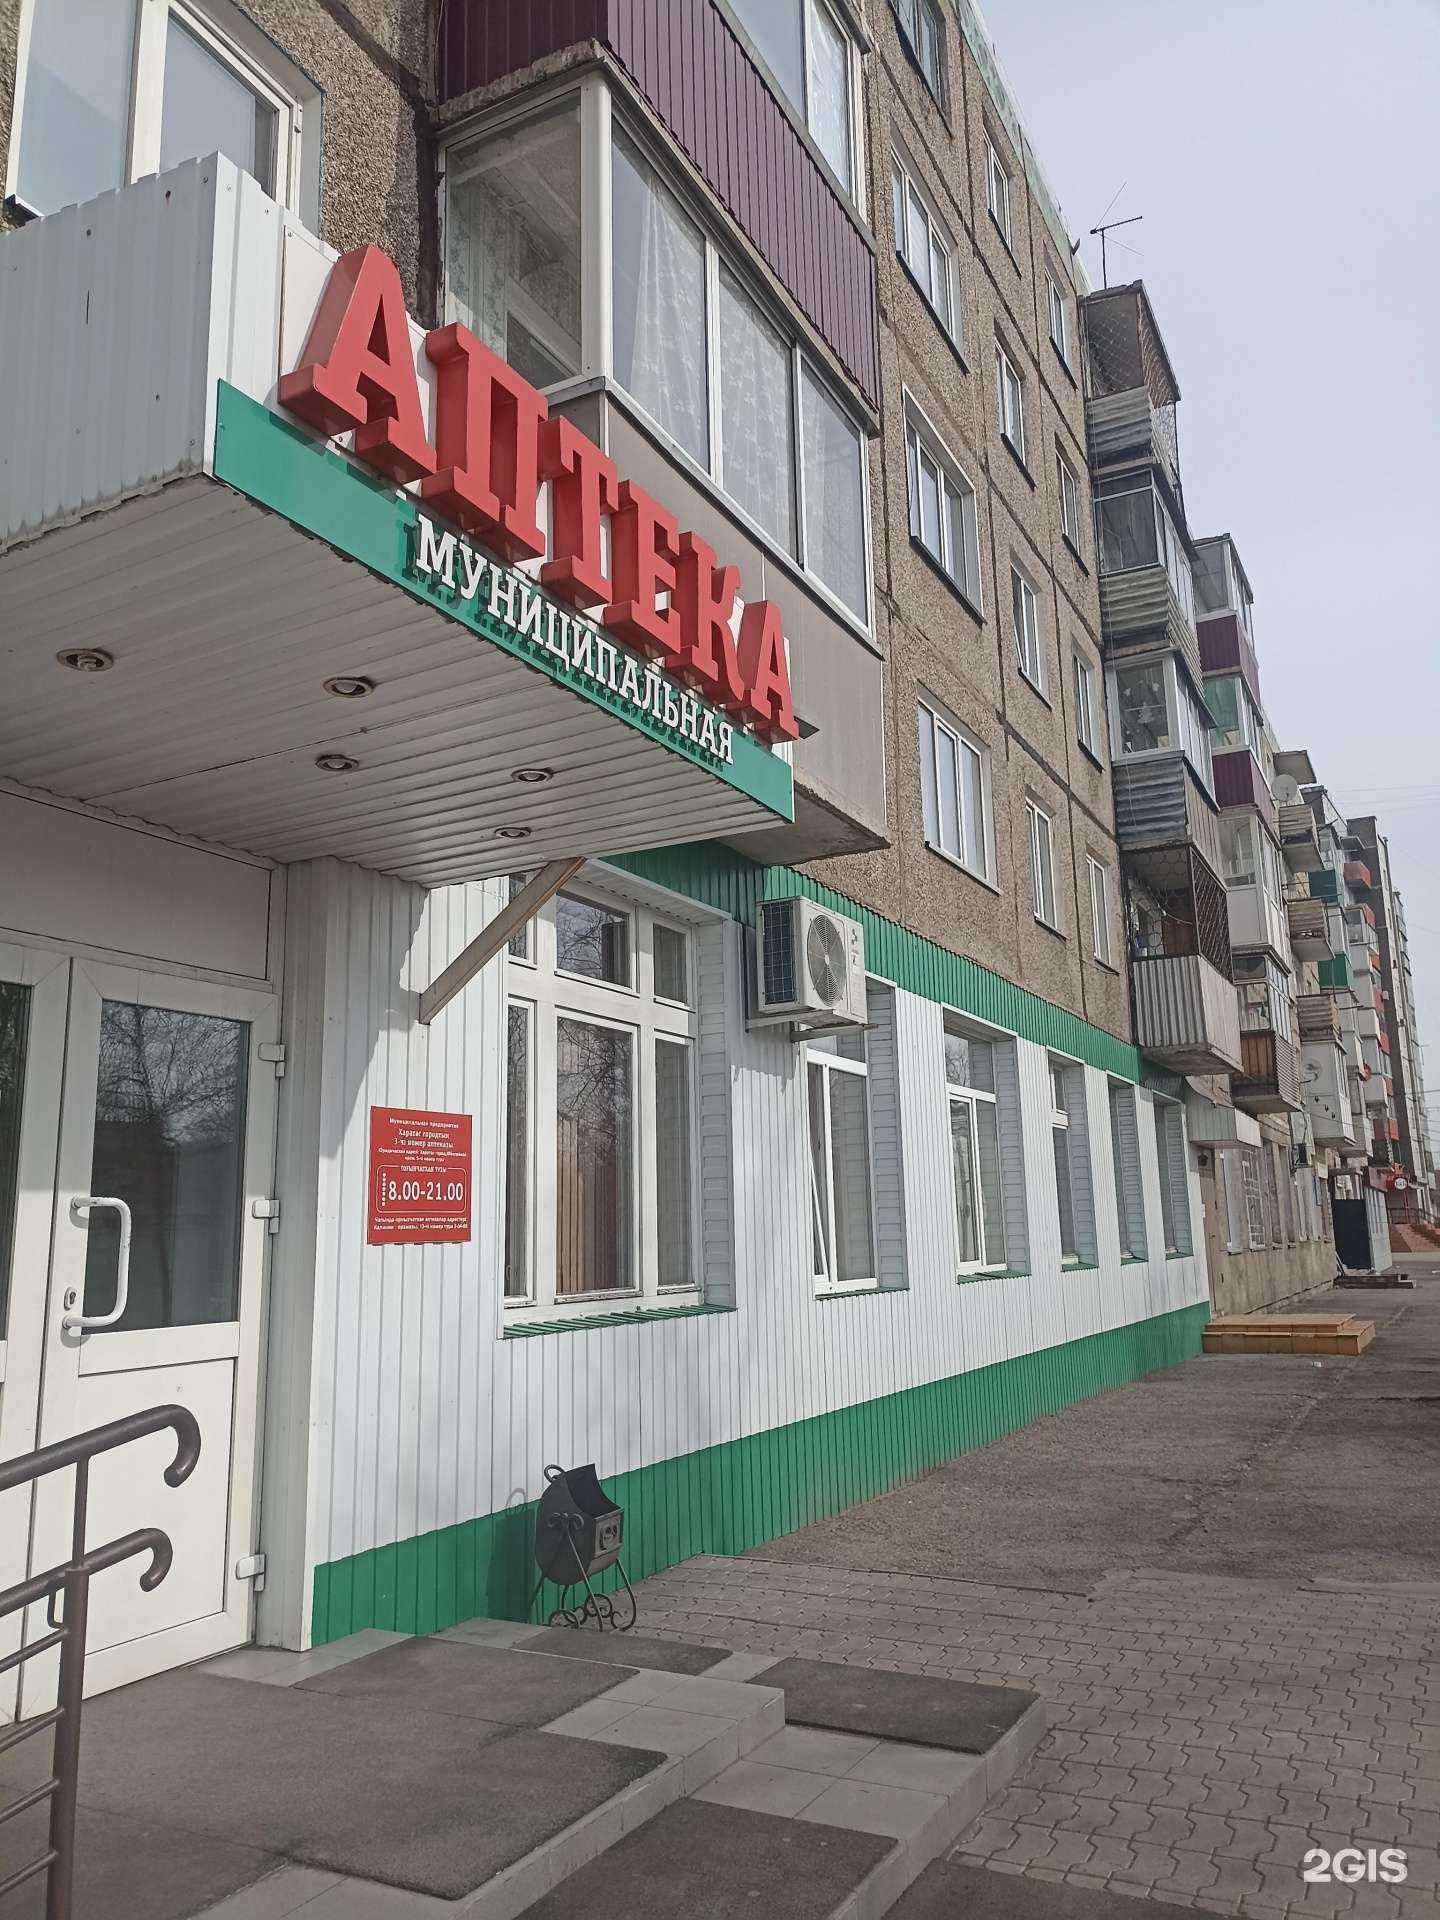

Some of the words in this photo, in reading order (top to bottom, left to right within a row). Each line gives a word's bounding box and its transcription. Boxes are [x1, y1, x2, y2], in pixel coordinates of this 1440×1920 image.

[279, 244, 799, 746] АПТЕКА
[415, 512, 735, 765] МУНИЦИПАЛЬНАЯ
[388, 1180, 464, 1201] 8.00-21.00
